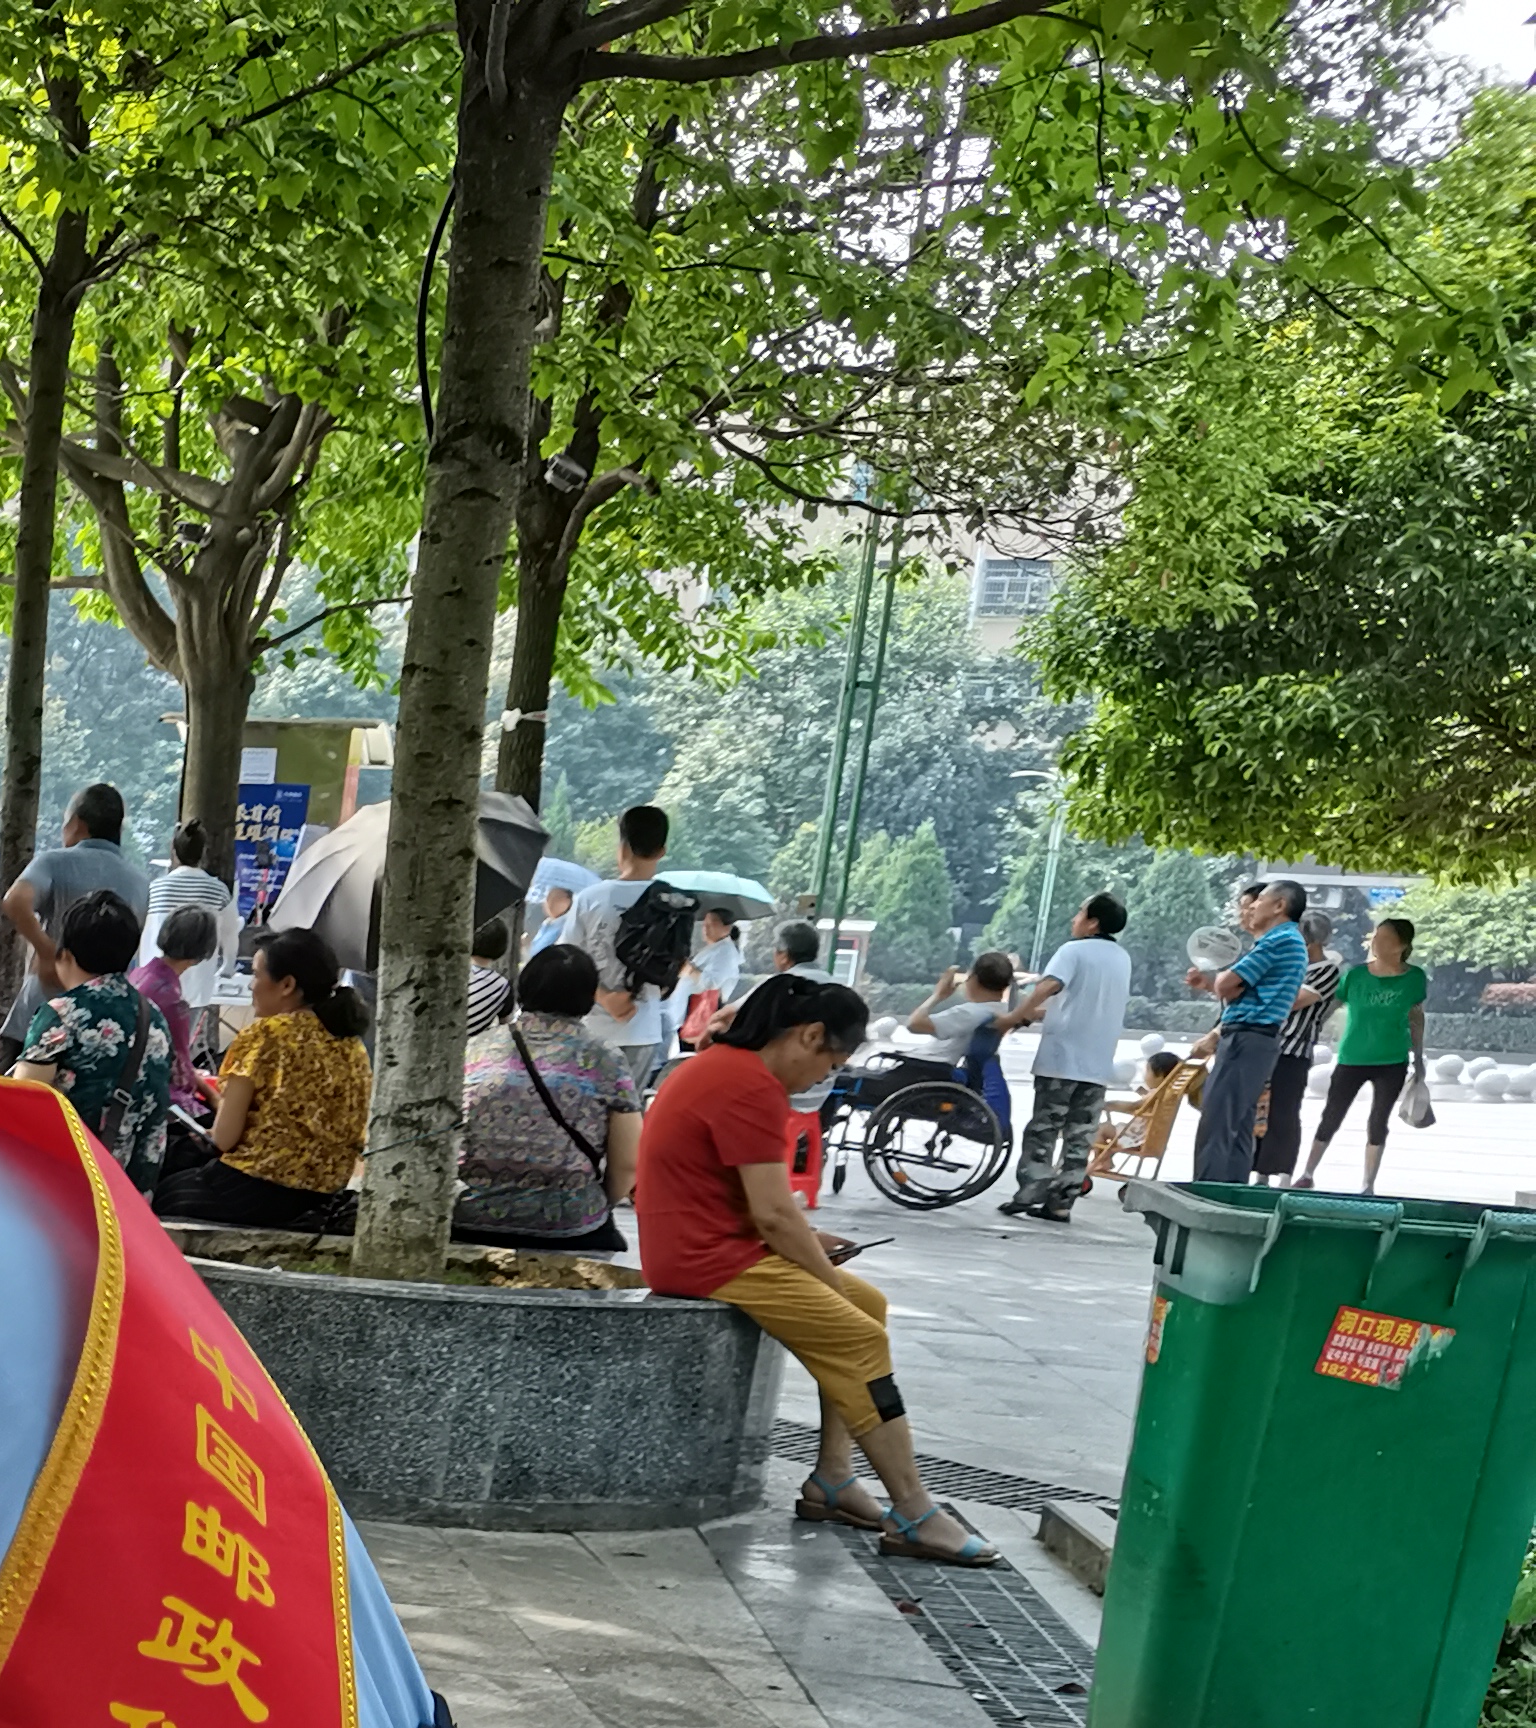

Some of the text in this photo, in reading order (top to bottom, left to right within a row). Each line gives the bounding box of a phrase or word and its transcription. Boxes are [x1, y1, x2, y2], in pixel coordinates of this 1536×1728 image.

[1337, 1310, 1441, 1347] 洞口现房
[1321, 1361, 1347, 1377] 182
[1351, 1367, 1379, 1384] 744
